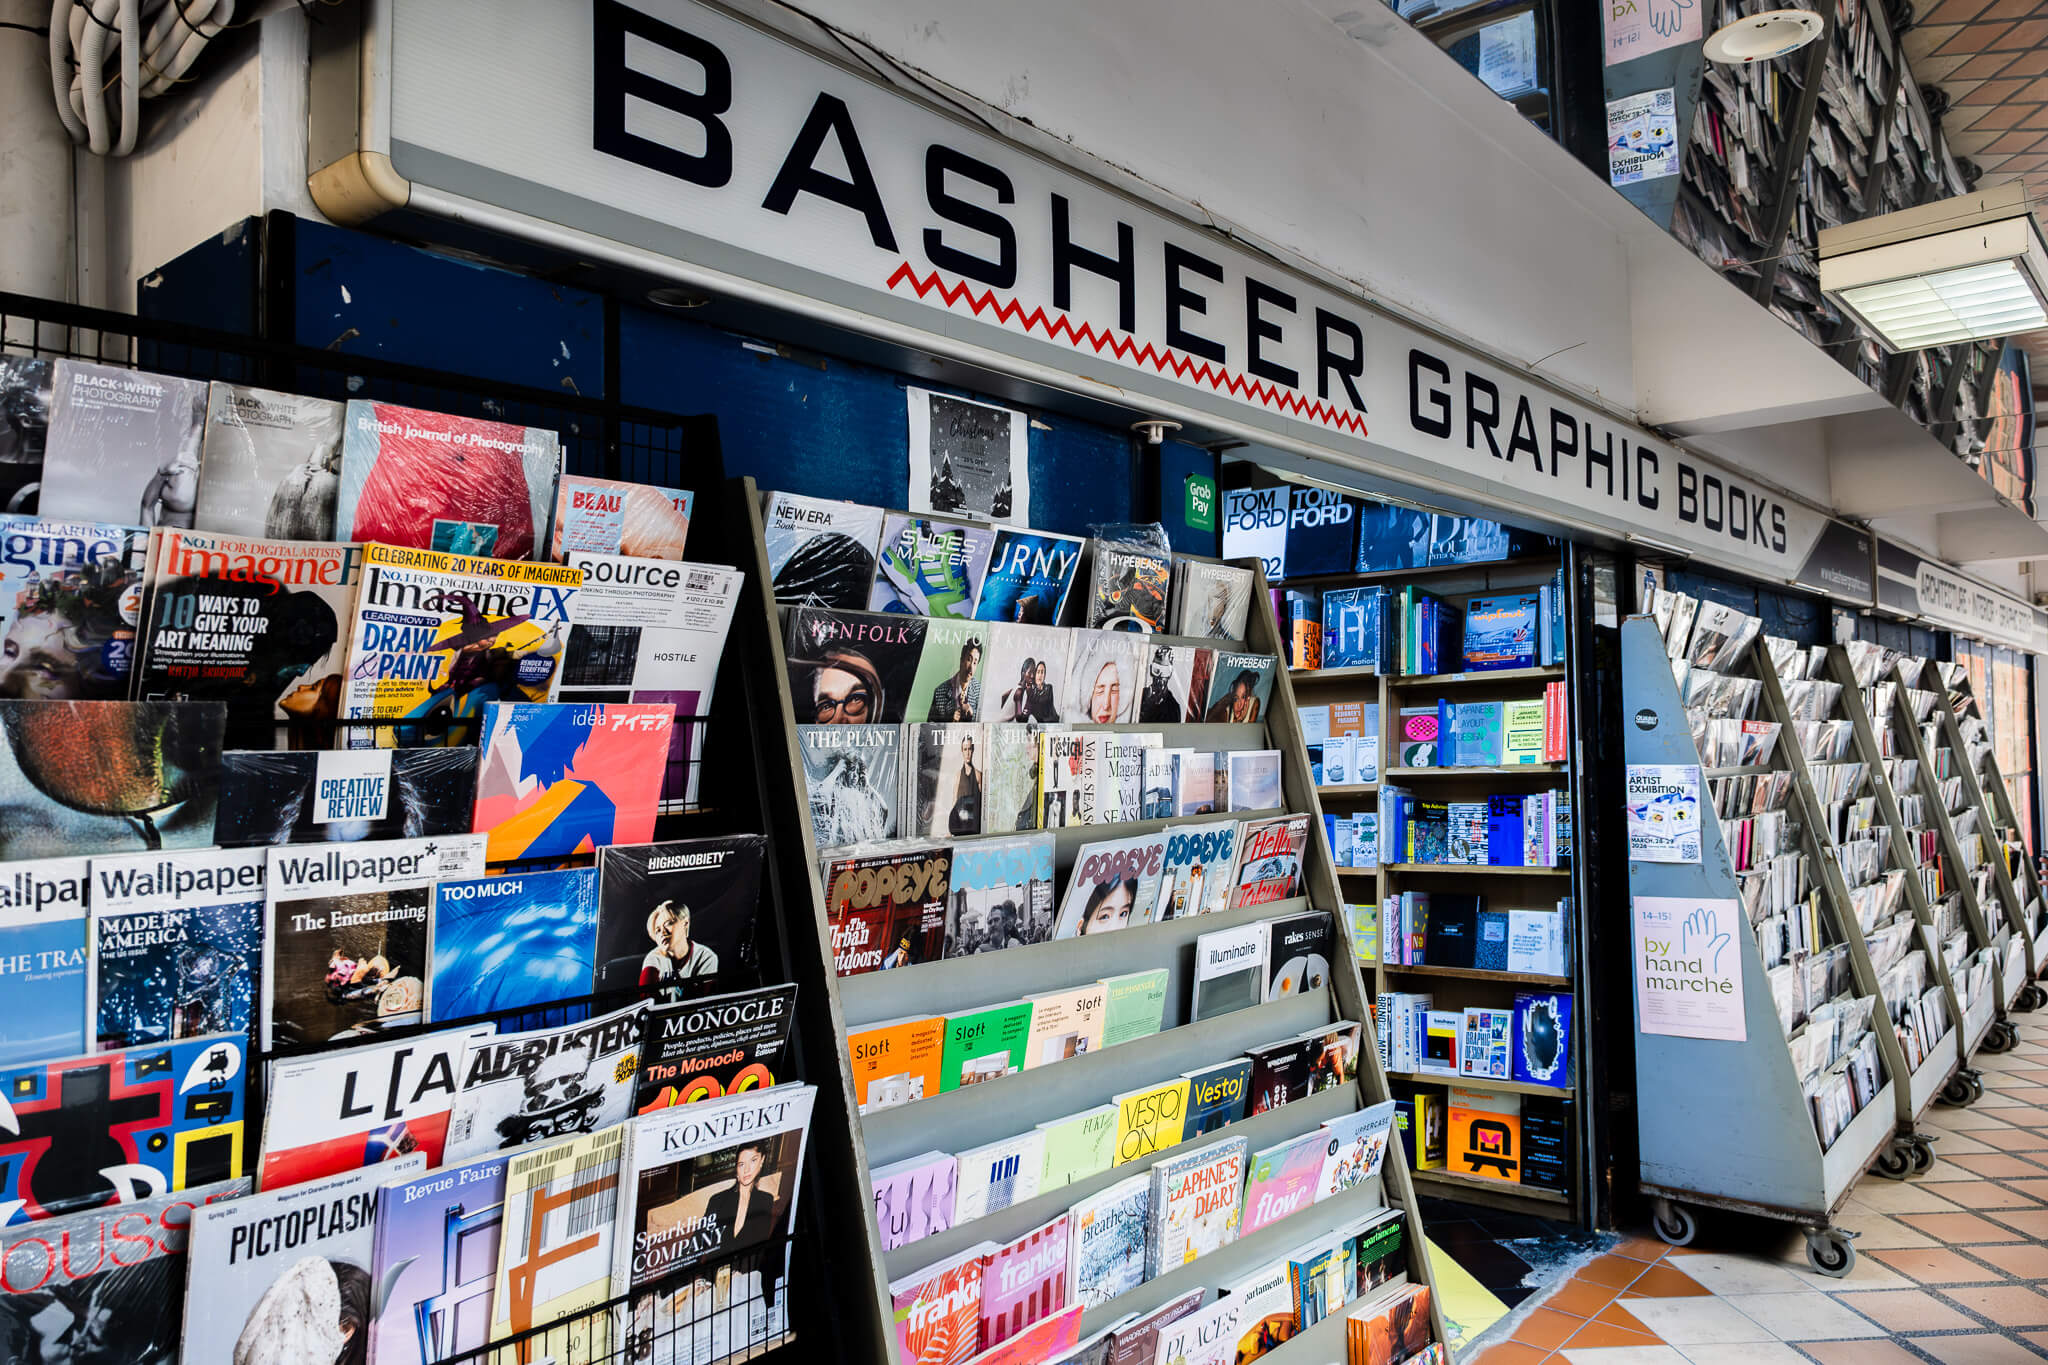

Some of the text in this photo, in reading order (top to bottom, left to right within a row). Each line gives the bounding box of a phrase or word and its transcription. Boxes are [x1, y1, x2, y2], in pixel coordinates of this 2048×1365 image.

[593, 0, 1787, 554] BASHEER GRAPHIC BOOKS
[72, 384, 162, 408] PHOTOGRAPHY
[358, 417, 546, 455] British Journal of Photography
[572, 491, 622, 514] BEAU
[1189, 482, 1211, 500] Grab
[1229, 490, 1276, 514] TOM
[1293, 487, 1343, 510] TOM
[672, 497, 688, 512] 11
[776, 505, 832, 526] NEW ERA
[1192, 496, 1209, 516] Pay
[1290, 503, 1352, 529] FORD
[775, 519, 796, 532] Book
[1226, 508, 1287, 533] FORD
[220, 540, 341, 559] FOR DIGITAL ARTISTS
[900, 530, 979, 553] SHOES
[371, 546, 581, 586] CELEBRATING 20 YEARS OF IMAGINEFX!
[897, 546, 974, 568] MASTER
[991, 541, 1078, 581] JRNY
[1110, 552, 1163, 572] HYPEBEAST
[412, 572, 531, 596] FOR DIGITAL ARTISTS
[578, 560, 680, 588] source
[1200, 567, 1248, 582] HYPEBEAST
[604, 589, 676, 599] THROUGH PHOTOGRAPHY
[160, 592, 195, 629] 10
[199, 595, 239, 615] WAYS
[242, 598, 260, 615] TO
[365, 611, 438, 626] LEARN HOW TO
[195, 614, 269, 634] GIVE YOUR
[812, 619, 911, 645] KINFOLK
[154, 630, 254, 652] ART MEANING
[362, 622, 438, 653] DRAW
[153, 657, 172, 665] using
[154, 649, 193, 658] Strengthen
[654, 652, 697, 663] HOSTILE
[1226, 655, 1272, 670] HYPEBEAST
[377, 655, 446, 681] PAINT
[350, 706, 361, 720] 15
[385, 706, 403, 714] CRAFT
[572, 709, 607, 728] idea
[807, 729, 896, 748] THE PLANT
[320, 776, 384, 800] CREATIVE
[1629, 776, 1662, 785] ARTIST
[1629, 785, 1685, 794] EXHIBITION
[327, 798, 383, 819] REVIEW
[1118, 789, 1137, 808] Vol.
[1164, 828, 1235, 867] POPEYE
[1250, 825, 1292, 863] Hello,
[648, 850, 725, 872] HIGHSNOBIETY
[952, 844, 1053, 893] POPEYE
[1077, 843, 1164, 889] POPEYE
[441, 880, 523, 902] TOO MUCH
[830, 857, 949, 913] POPEYE
[101, 912, 184, 936] MADE IN
[291, 904, 427, 933] The Entertaining
[850, 917, 866, 931] The
[101, 927, 190, 950] AMERICA
[829, 924, 870, 949] Urban
[1284, 928, 1325, 946] rakes SENSE
[1644, 936, 1671, 956] by
[101, 951, 116, 960] THE
[1210, 941, 1256, 966] illuminaire
[1645, 955, 1703, 975] hand
[1646, 975, 1734, 995] marché
[1076, 995, 1102, 1012] Sloft
[661, 997, 785, 1038] MONOCLE
[663, 1041, 686, 1051] People,
[686, 1035, 713, 1047] products,
[713, 1032, 735, 1042] policies,
[736, 1028, 752, 1039] places
[955, 1022, 986, 1041] Sloft
[1466, 1031, 1491, 1046] GRAPHIC
[463, 1003, 650, 1090] ADBUSTERS
[755, 1048, 778, 1057] Edition
[756, 1039, 785, 1050] Premiere
[855, 1038, 890, 1060] Sloft
[1465, 1045, 1485, 1060] DESIGN
[647, 1064, 676, 1082] The
[681, 1049, 745, 1076] Monocle
[1194, 1070, 1245, 1107] Vestoj
[1125, 1087, 1183, 1129] VESTOJ
[662, 1102, 791, 1153] KONFEKT
[1354, 1116, 1391, 1136] UPPERCASE
[1121, 1128, 1157, 1159] ON
[308, 1184, 329, 1194] Character
[331, 1180, 346, 1189] Design
[403, 1166, 502, 1204] Revue Faire
[1169, 1157, 1239, 1202] DAPHNE'S
[1193, 1182, 1239, 1220] DIARY
[1253, 1184, 1309, 1228] flow
[208, 1210, 227, 1220] Spring
[1082, 1208, 1125, 1245] Breathe
[635, 1213, 717, 1252] Sparkling
[1363, 1223, 1400, 1248] apartamento
[633, 1225, 727, 1274] COMPANY
[1000, 1235, 1066, 1292] frankie
[1310, 1250, 1350, 1276] apartamento
[1120, 1324, 1150, 1347] WARDROBE
[1166, 1307, 1240, 1358] PLACES
